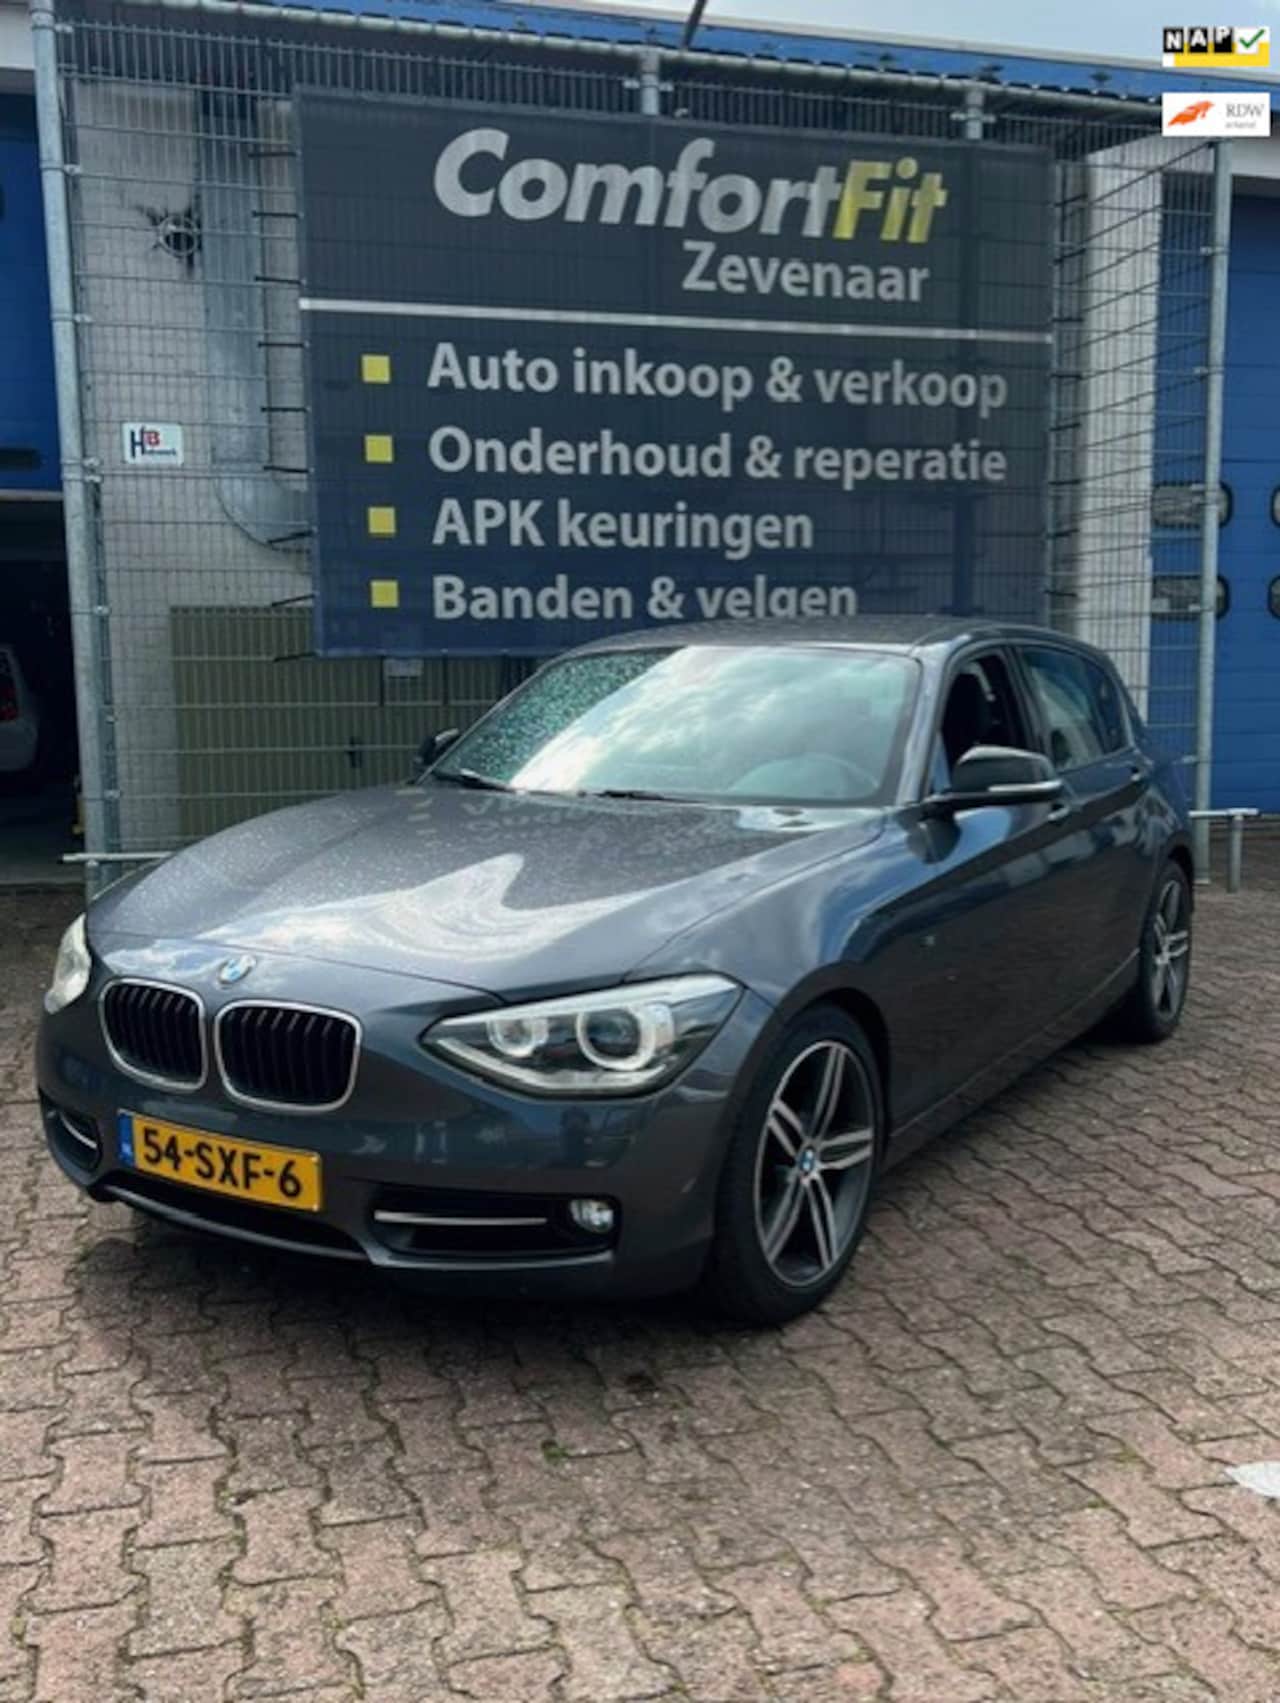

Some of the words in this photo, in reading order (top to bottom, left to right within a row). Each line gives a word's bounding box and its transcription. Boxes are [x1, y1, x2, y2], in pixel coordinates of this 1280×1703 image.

[433, 127, 947, 243] ComfortFit
[681, 240, 930, 302] Zevenaar
[427, 342, 559, 394] Auto
[572, 347, 753, 412] inkoop
[765, 356, 803, 402] &
[813, 361, 1008, 418] verkoop
[428, 425, 732, 480] Onderhoud
[744, 434, 782, 481] &
[793, 438, 1008, 490] reperatie
[432, 499, 544, 547] APK
[557, 499, 813, 560] keuringen
[432, 574, 633, 620] Banden
[646, 577, 685, 618] &
[143, 1127, 302, 1198] 54-SXF-6
